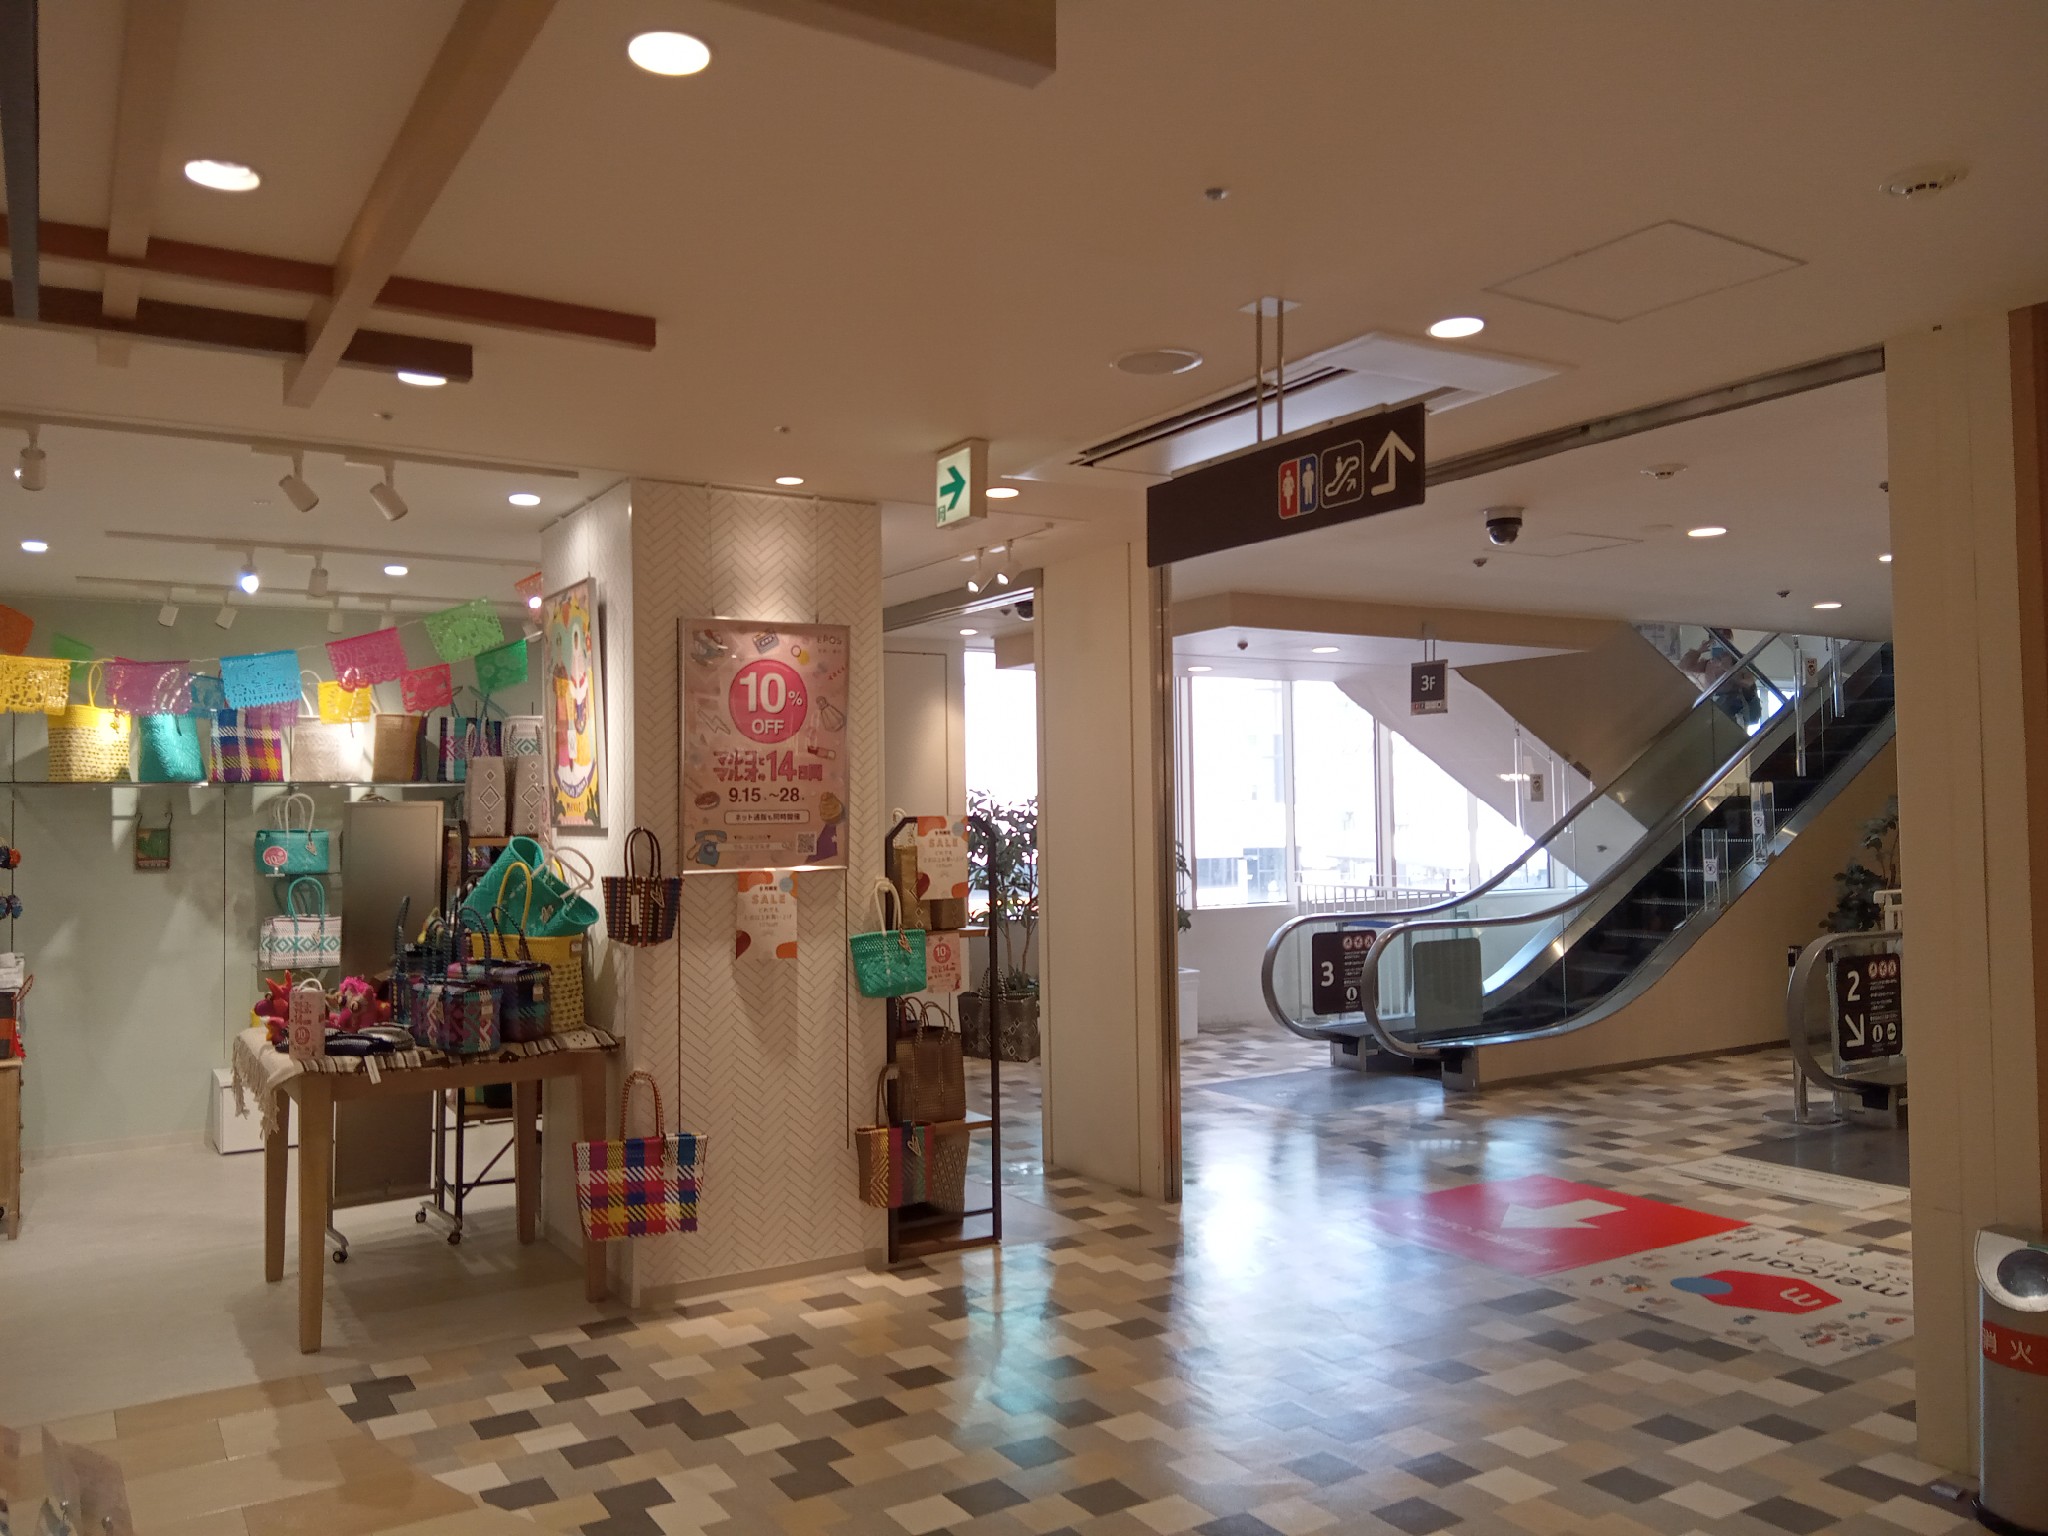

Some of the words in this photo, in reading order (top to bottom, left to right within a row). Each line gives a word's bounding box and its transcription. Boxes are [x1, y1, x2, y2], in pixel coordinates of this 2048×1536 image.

[1421, 674, 1436, 691] 3F
[751, 718, 785, 734] OFF
[751, 894, 786, 905] SALE
[1320, 961, 1335, 987] 3
[1847, 970, 1861, 1001] 2
